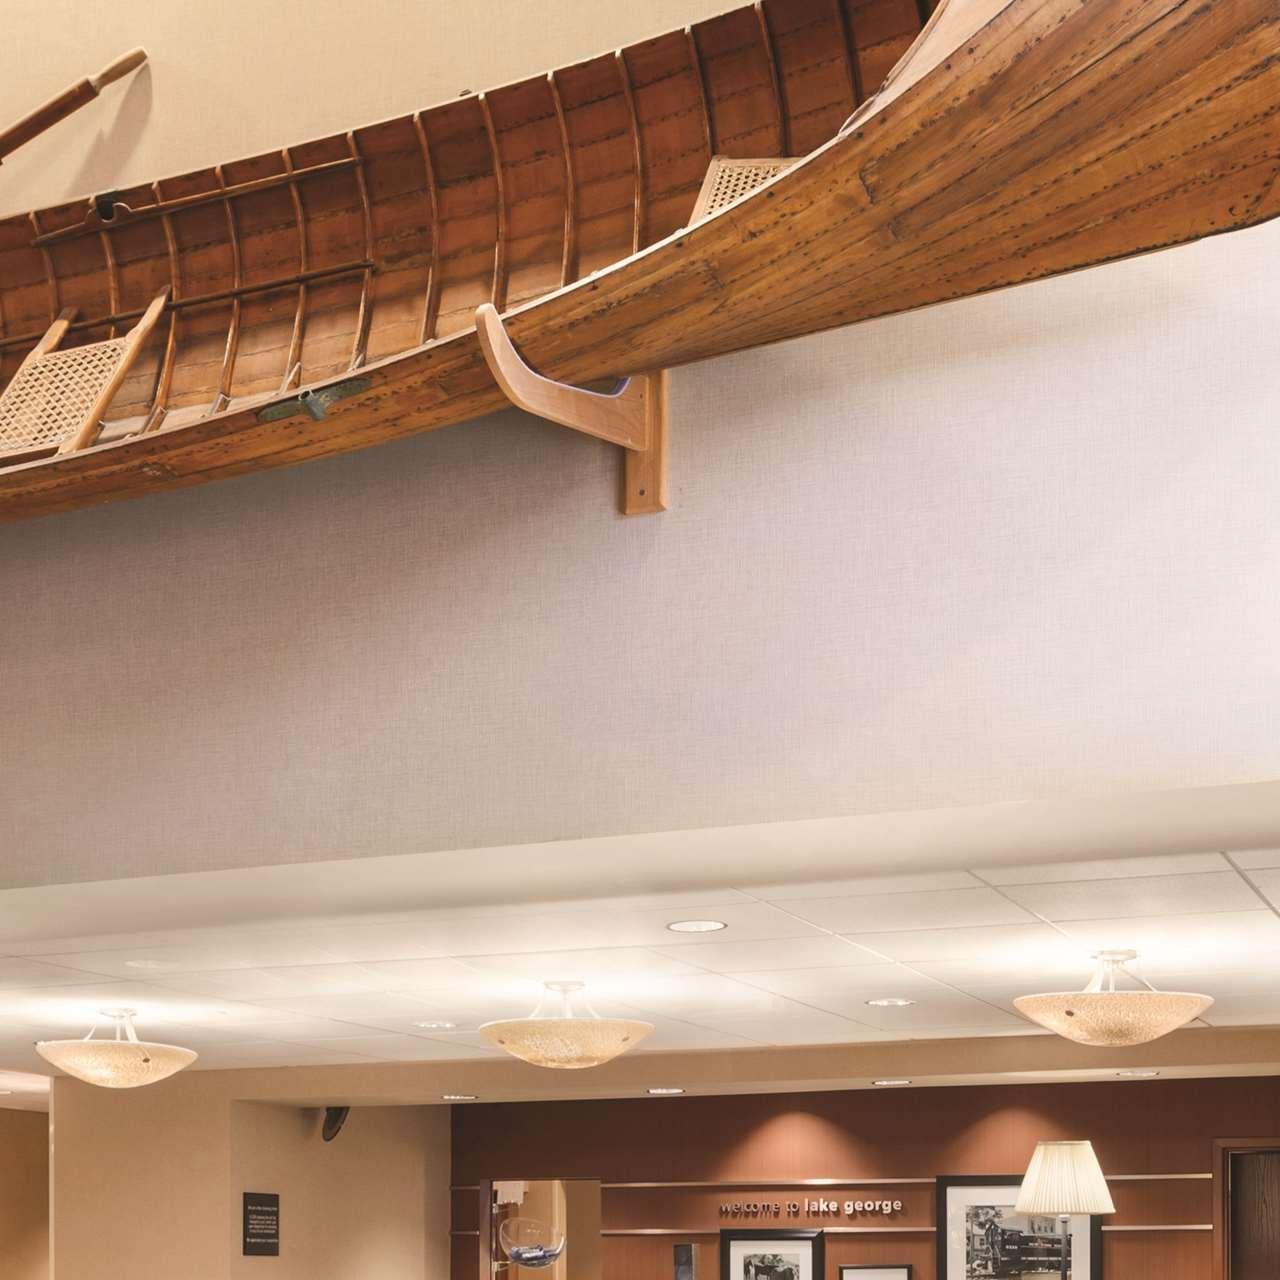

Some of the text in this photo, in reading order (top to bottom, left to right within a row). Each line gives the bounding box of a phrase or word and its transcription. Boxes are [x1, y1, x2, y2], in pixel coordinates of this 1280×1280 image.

[720, 1198, 903, 1215] welcome to lake george
